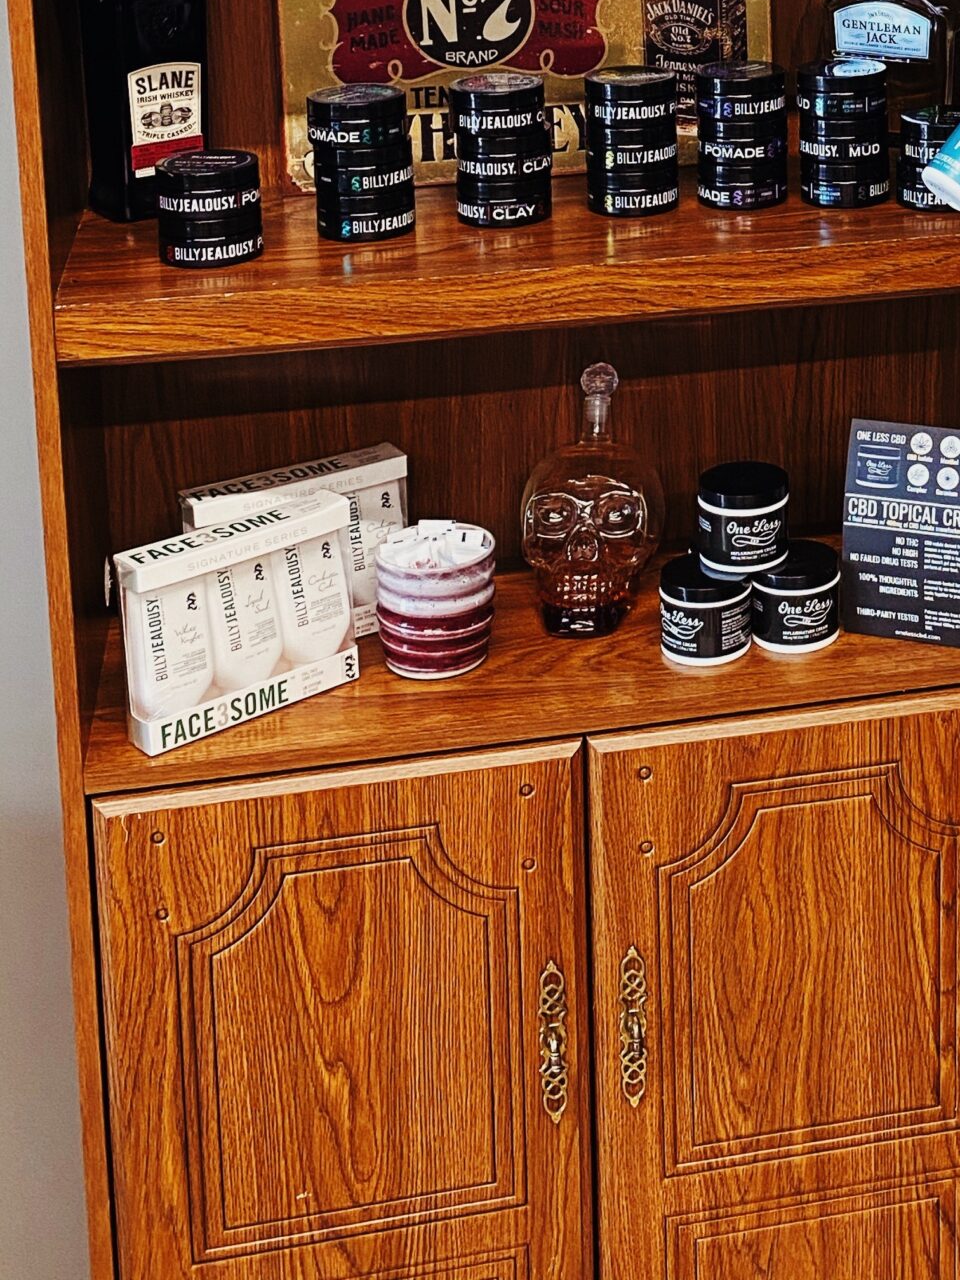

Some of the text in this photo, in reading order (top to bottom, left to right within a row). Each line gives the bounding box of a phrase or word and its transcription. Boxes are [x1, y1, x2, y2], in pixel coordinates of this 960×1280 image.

[647, 0, 671, 20] JACK
[537, 21, 584, 40] MASH
[671, 25, 689, 36] Old
[842, 18, 921, 35] GENTLEMAN
[351, 28, 400, 51] MADE
[866, 32, 897, 44] JACK
[445, 49, 499, 65] BRAND
[135, 70, 195, 96] SLANE
[137, 89, 194, 104] IRISH WHISKEY
[142, 123, 193, 140] TRIPLE CASKED
[704, 144, 765, 159] POMADE
[492, 205, 536, 220] CLAY
[857, 430, 906, 445] ONE LESS CBD
[190, 457, 349, 502] FACE3SOME
[848, 497, 878, 517] CBD
[881, 501, 939, 525] TOPICAL
[726, 518, 782, 535] One Less
[128, 509, 291, 565] FACE3SOME
[895, 537, 919, 547] NO THC
[187, 526, 308, 572] SIGNATURE SERIES
[892, 547, 919, 558] NO HIGH
[849, 552, 919, 569] NO FAILED DRUG TESTS
[858, 572, 918, 588] 100% THOUGHTFUL
[778, 598, 832, 615] One Less
[856, 606, 896, 620] THIRD-PARTY
[897, 611, 919, 623] TESTED
[672, 609, 704, 627] Less
[160, 679, 289, 749] FACE3SOME
